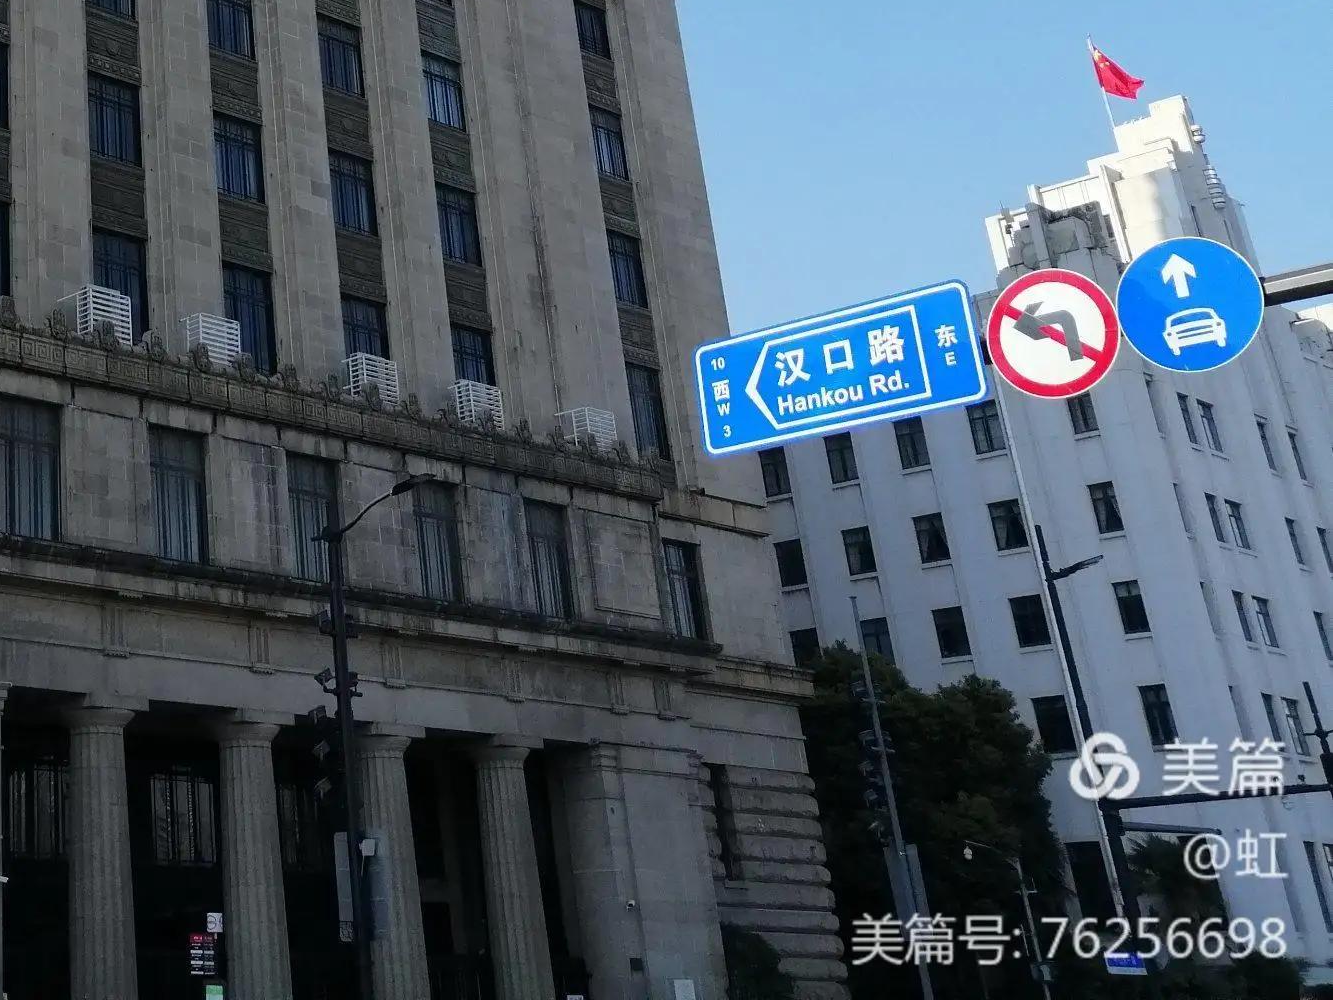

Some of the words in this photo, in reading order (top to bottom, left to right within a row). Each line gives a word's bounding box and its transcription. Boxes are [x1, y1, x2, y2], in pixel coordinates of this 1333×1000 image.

[935, 324, 957, 347] 东
[710, 356, 726, 371] 10
[775, 325, 905, 387] 汉口路
[944, 352, 957, 366] E
[712, 379, 730, 401] 西
[777, 384, 864, 416] Hankou
[869, 369, 910, 396] Rd.
[717, 402, 731, 417] W
[722, 425, 732, 438] 3
